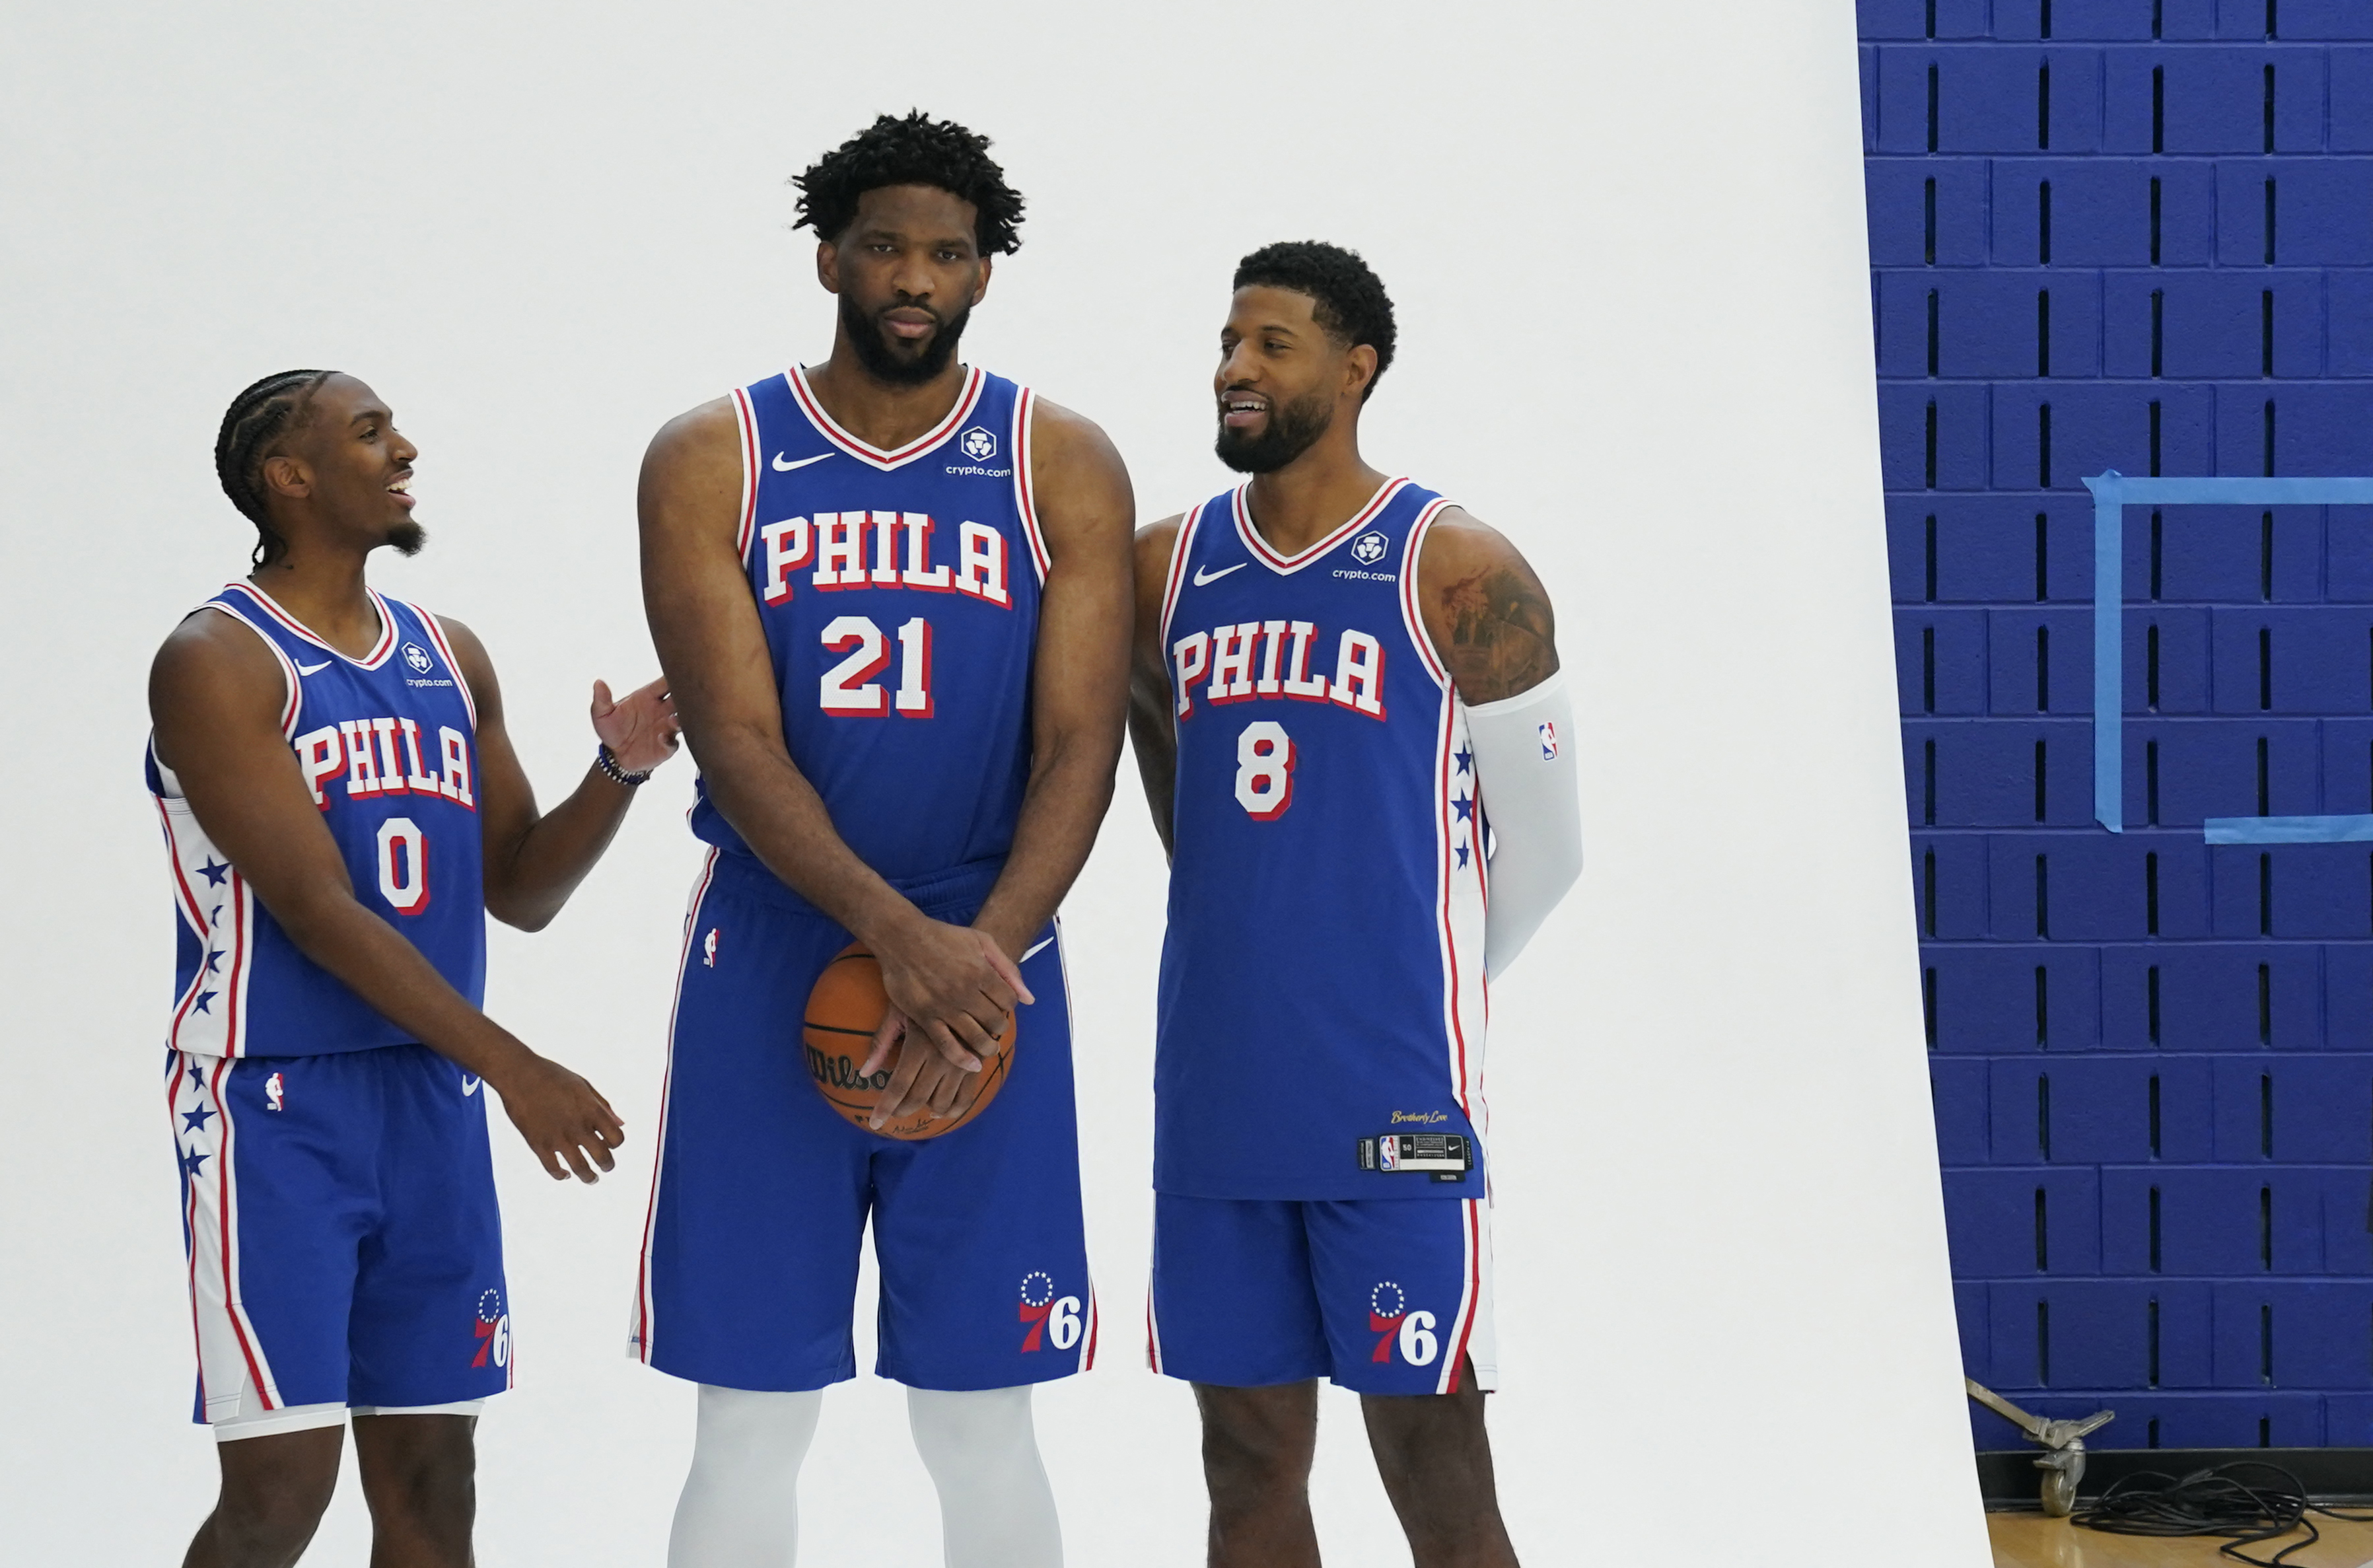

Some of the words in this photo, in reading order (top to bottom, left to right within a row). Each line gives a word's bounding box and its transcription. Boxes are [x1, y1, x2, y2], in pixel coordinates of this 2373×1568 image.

[946, 466, 1011, 478] crypto.com
[761, 511, 1012, 610] PHILA
[1332, 569, 1396, 583] crypto.com
[406, 678, 453, 688] crypto.com
[820, 616, 934, 719] 21
[1173, 620, 1386, 722] PHILA
[295, 717, 476, 813] PHILA
[1234, 721, 1296, 821] 8
[377, 817, 429, 915] 0
[806, 1043, 894, 1092] Wilso
[1402, 1143, 1412, 1152] 50
[471, 1314, 509, 1368] 76
[1019, 1295, 1082, 1354] 76
[1369, 1310, 1438, 1367] 76
